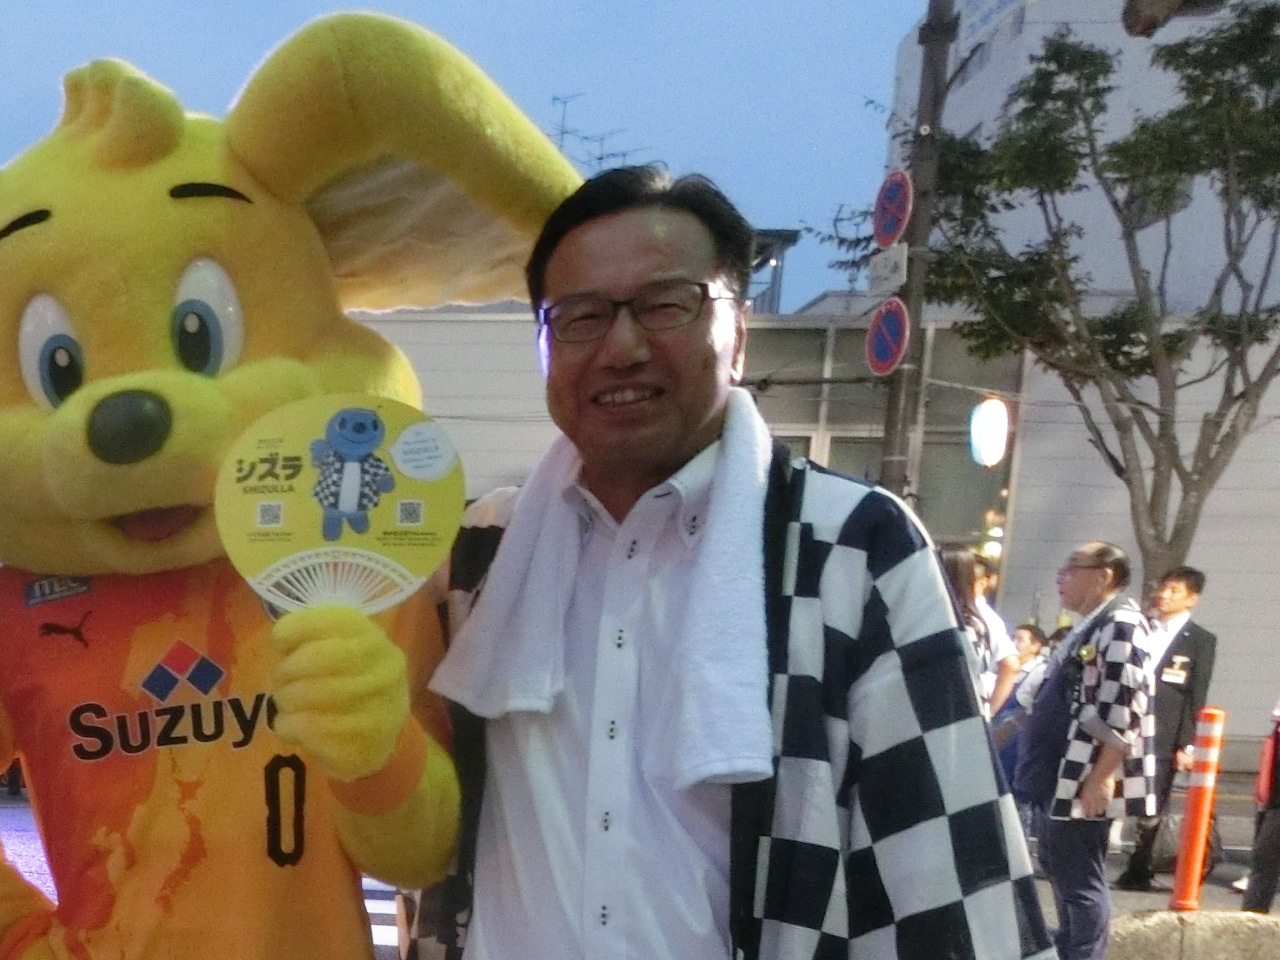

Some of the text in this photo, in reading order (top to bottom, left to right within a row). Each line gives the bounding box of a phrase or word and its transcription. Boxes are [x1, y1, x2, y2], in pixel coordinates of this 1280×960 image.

[235, 451, 304, 484] シズラ
[242, 484, 296, 494] SHIZULLA
[264, 753, 307, 868] 0
